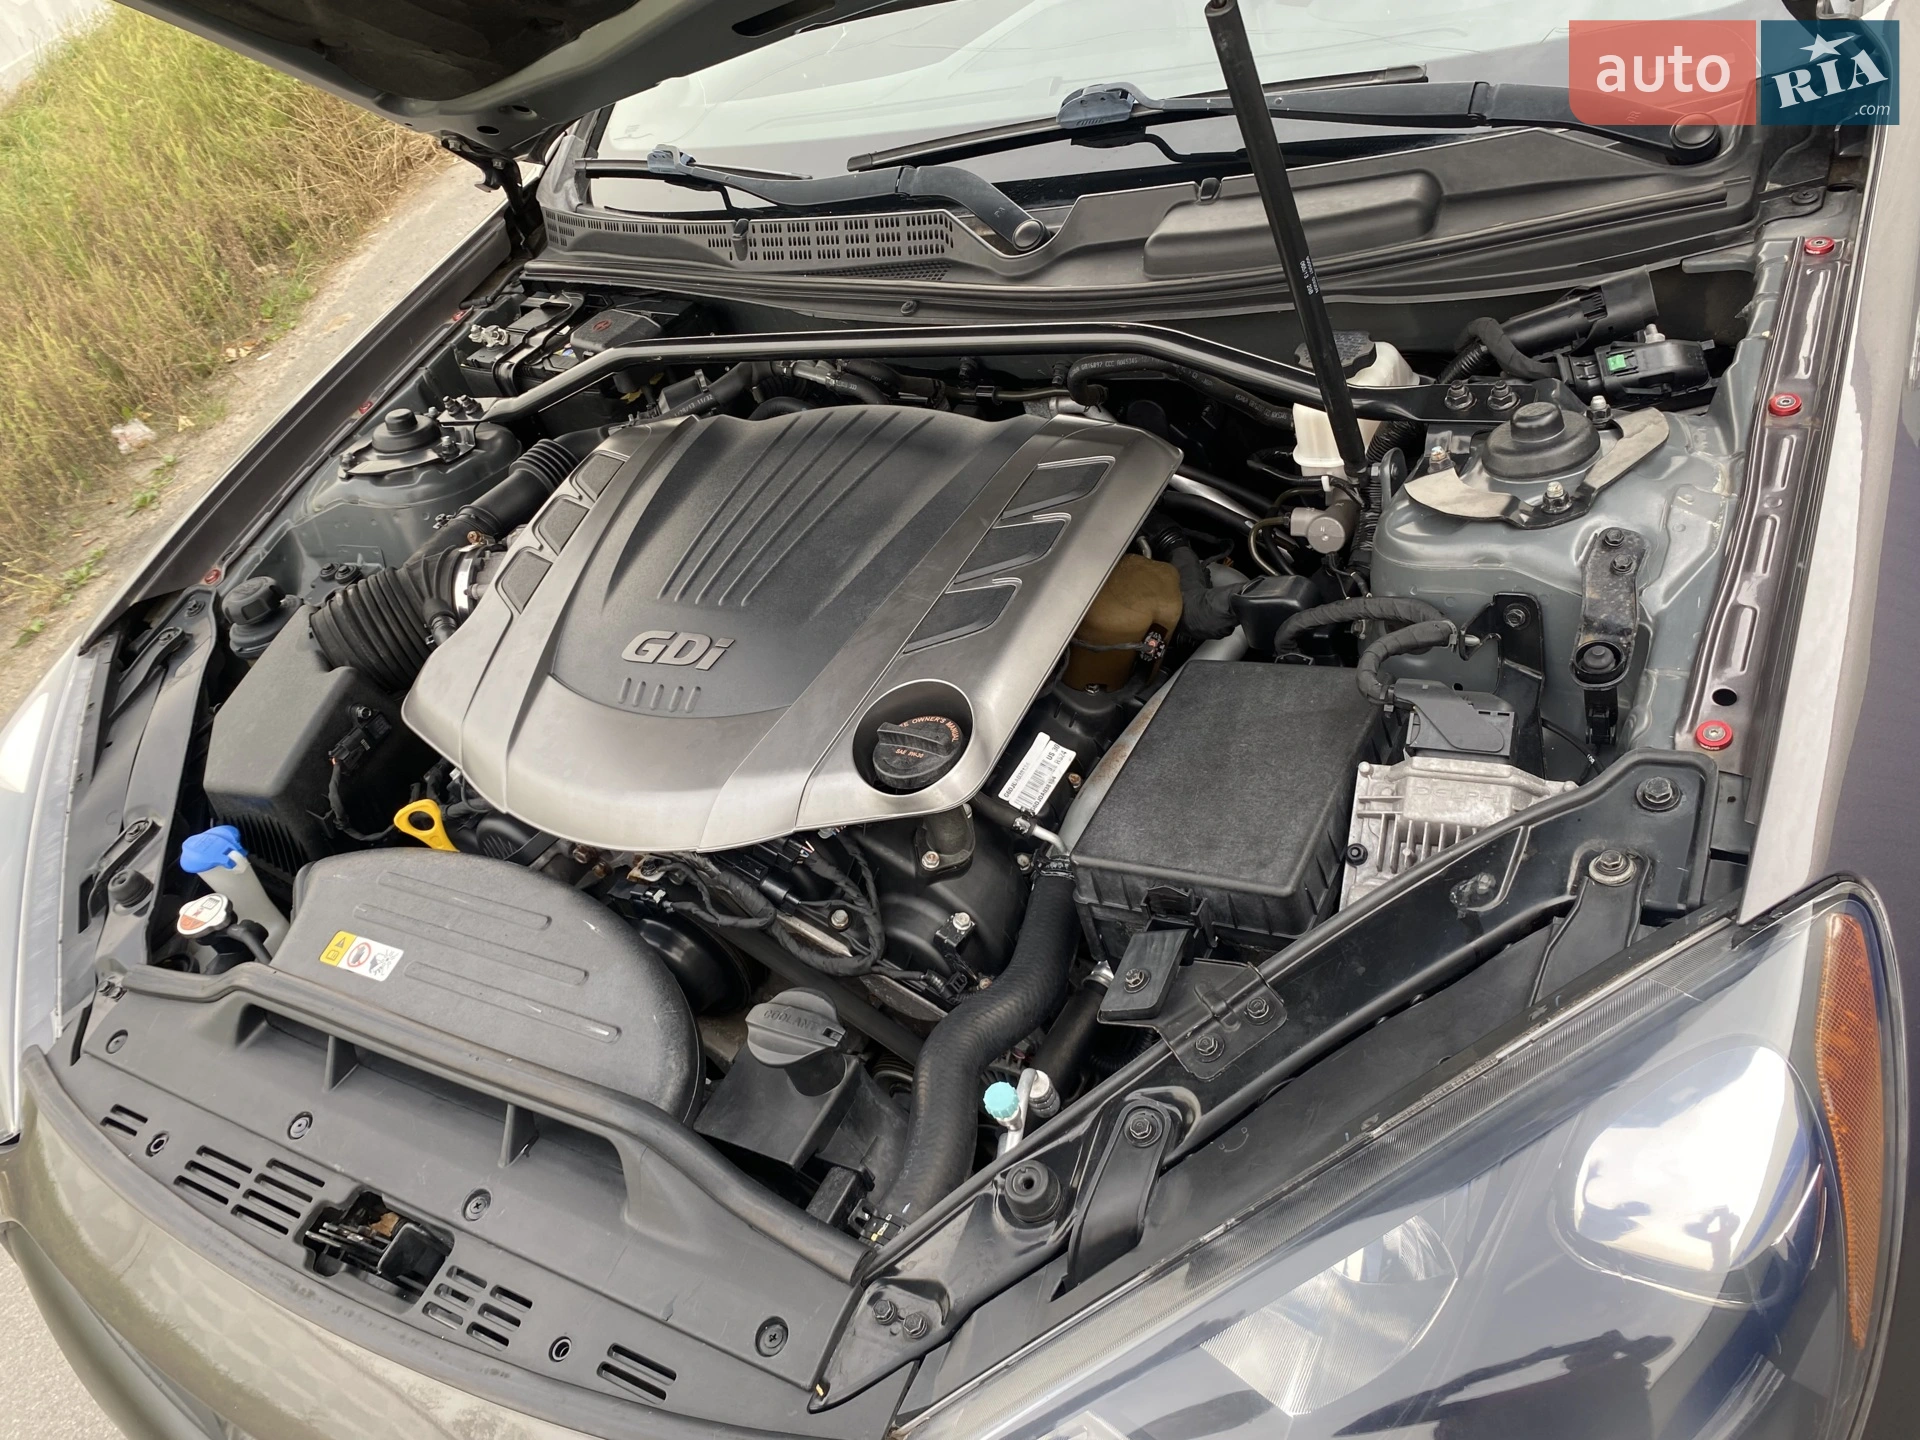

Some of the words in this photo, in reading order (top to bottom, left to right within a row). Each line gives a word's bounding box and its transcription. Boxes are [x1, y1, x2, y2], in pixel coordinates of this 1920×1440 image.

[621, 629, 736, 672] GDi
[912, 715, 947, 724] OWNER'S
[945, 720, 961, 742] MANUAL
[1412, 786, 1504, 805] DELPHI
[763, 1009, 820, 1031] COOLANT
